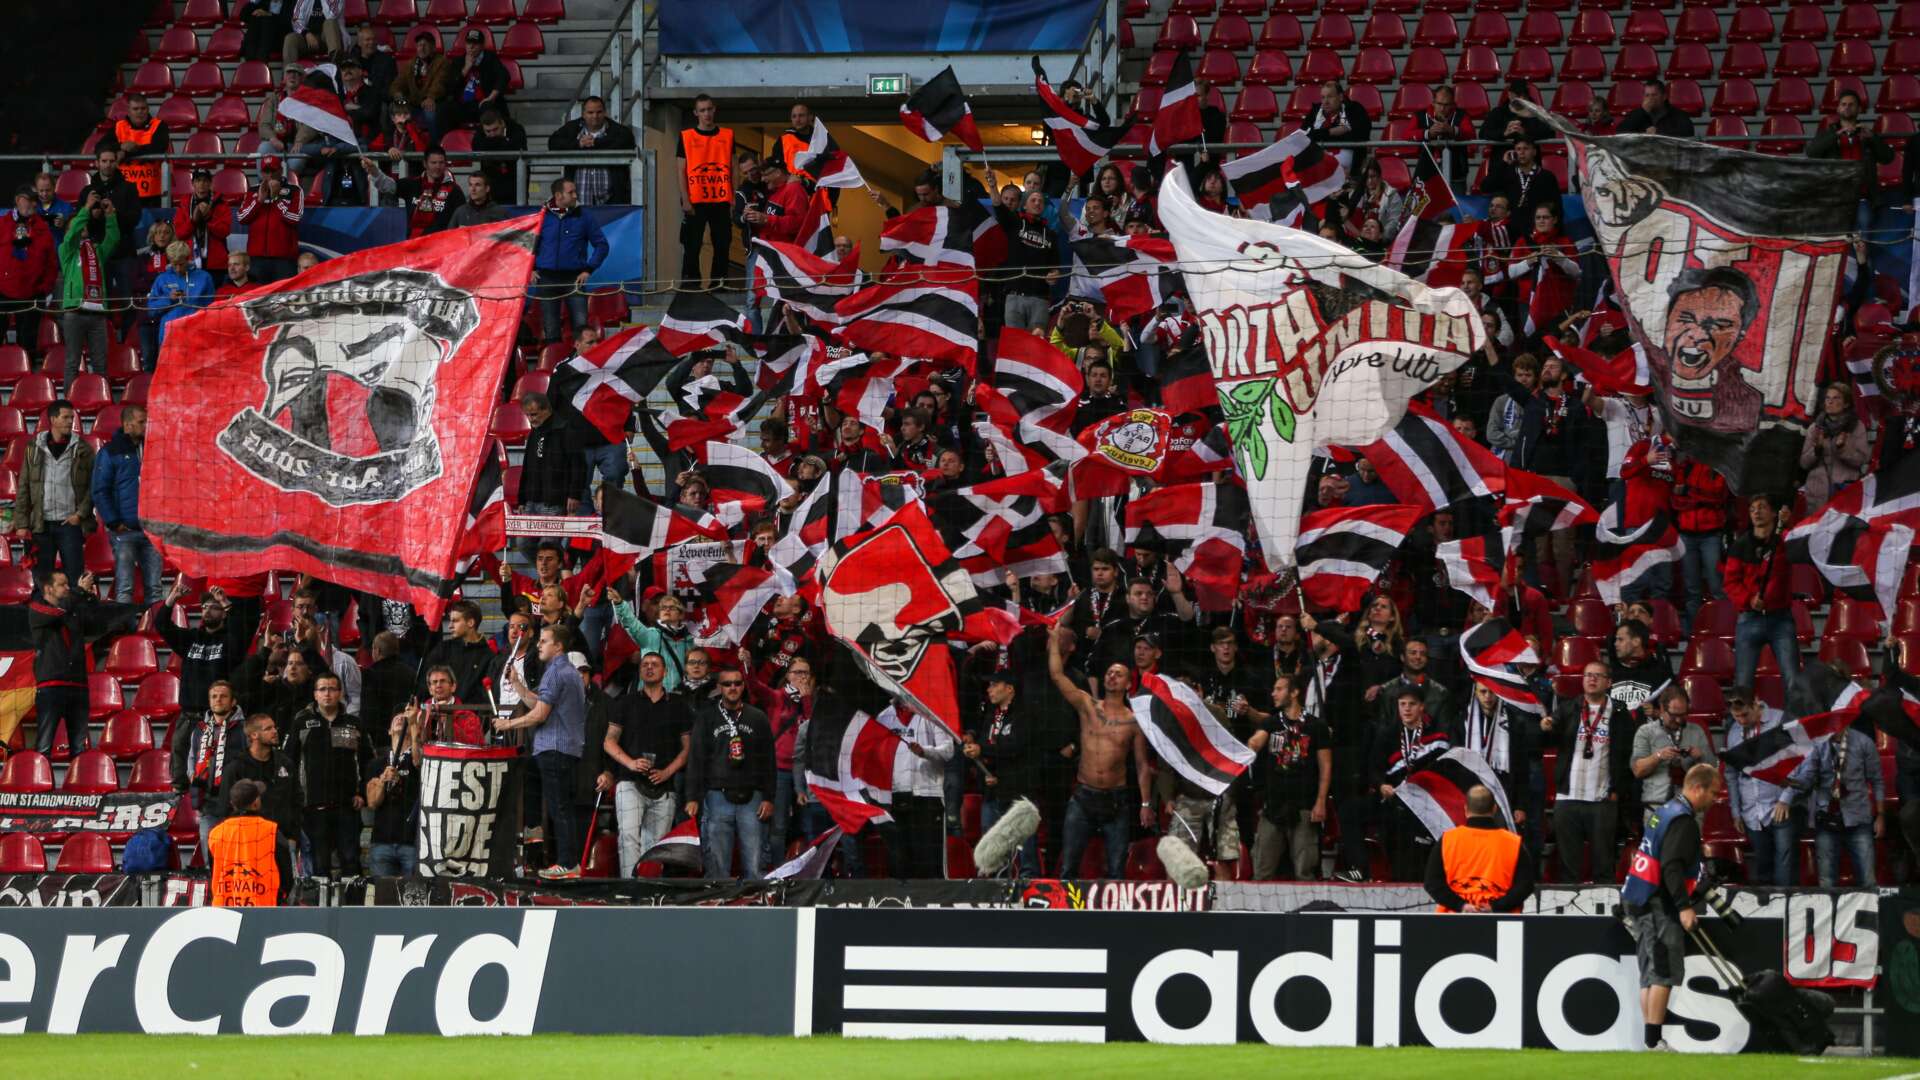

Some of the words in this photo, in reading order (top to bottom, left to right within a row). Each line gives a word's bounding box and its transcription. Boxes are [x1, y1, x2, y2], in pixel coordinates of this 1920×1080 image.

[689, 174, 729, 184] STEWAR
[702, 187, 727, 199] 316
[0, 793, 18, 806] ION
[1131, 919, 1752, 1054] adidas
